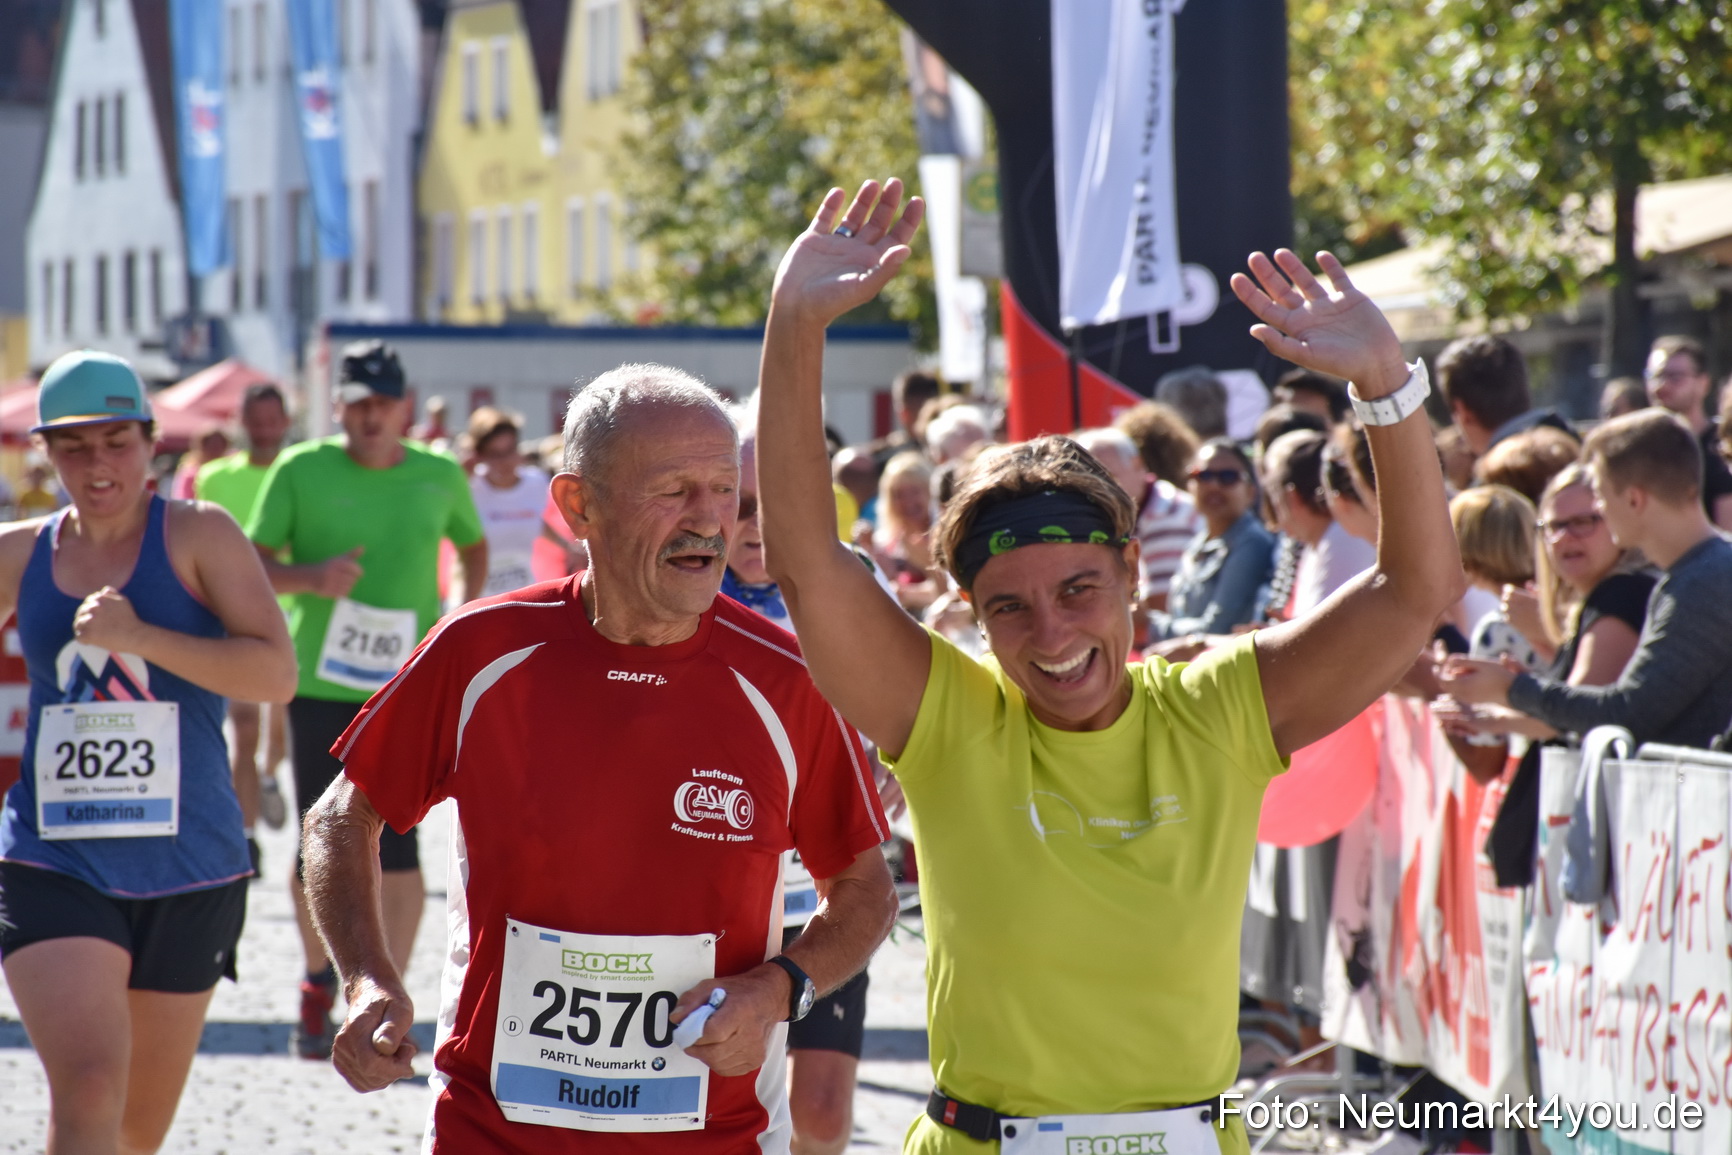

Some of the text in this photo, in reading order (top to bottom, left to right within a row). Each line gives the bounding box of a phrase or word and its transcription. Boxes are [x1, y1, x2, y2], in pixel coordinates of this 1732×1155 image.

[340, 625, 402, 659] 2180
[607, 670, 656, 684] CRAFT
[56, 739, 156, 779] 2623
[692, 768, 743, 785] Laufteam
[697, 785, 729, 810] ASV
[66, 803, 145, 822] Katharina
[692, 809, 727, 821] NEUMARKT
[1088, 817, 1131, 828] Kliniken
[671, 822, 716, 839] Kraftsport
[726, 834, 754, 842] Fitness
[562, 949, 654, 973] BOCK
[562, 969, 588, 980] inspired
[590, 973, 599, 981] by
[623, 974, 655, 982] concepts
[529, 980, 679, 1048] 2570
[509, 1021, 517, 1031] D
[540, 1048, 647, 1070] PARTL Neumarkt
[558, 1078, 640, 1108] Rudolf
[1066, 1132, 1168, 1155] BOCK
